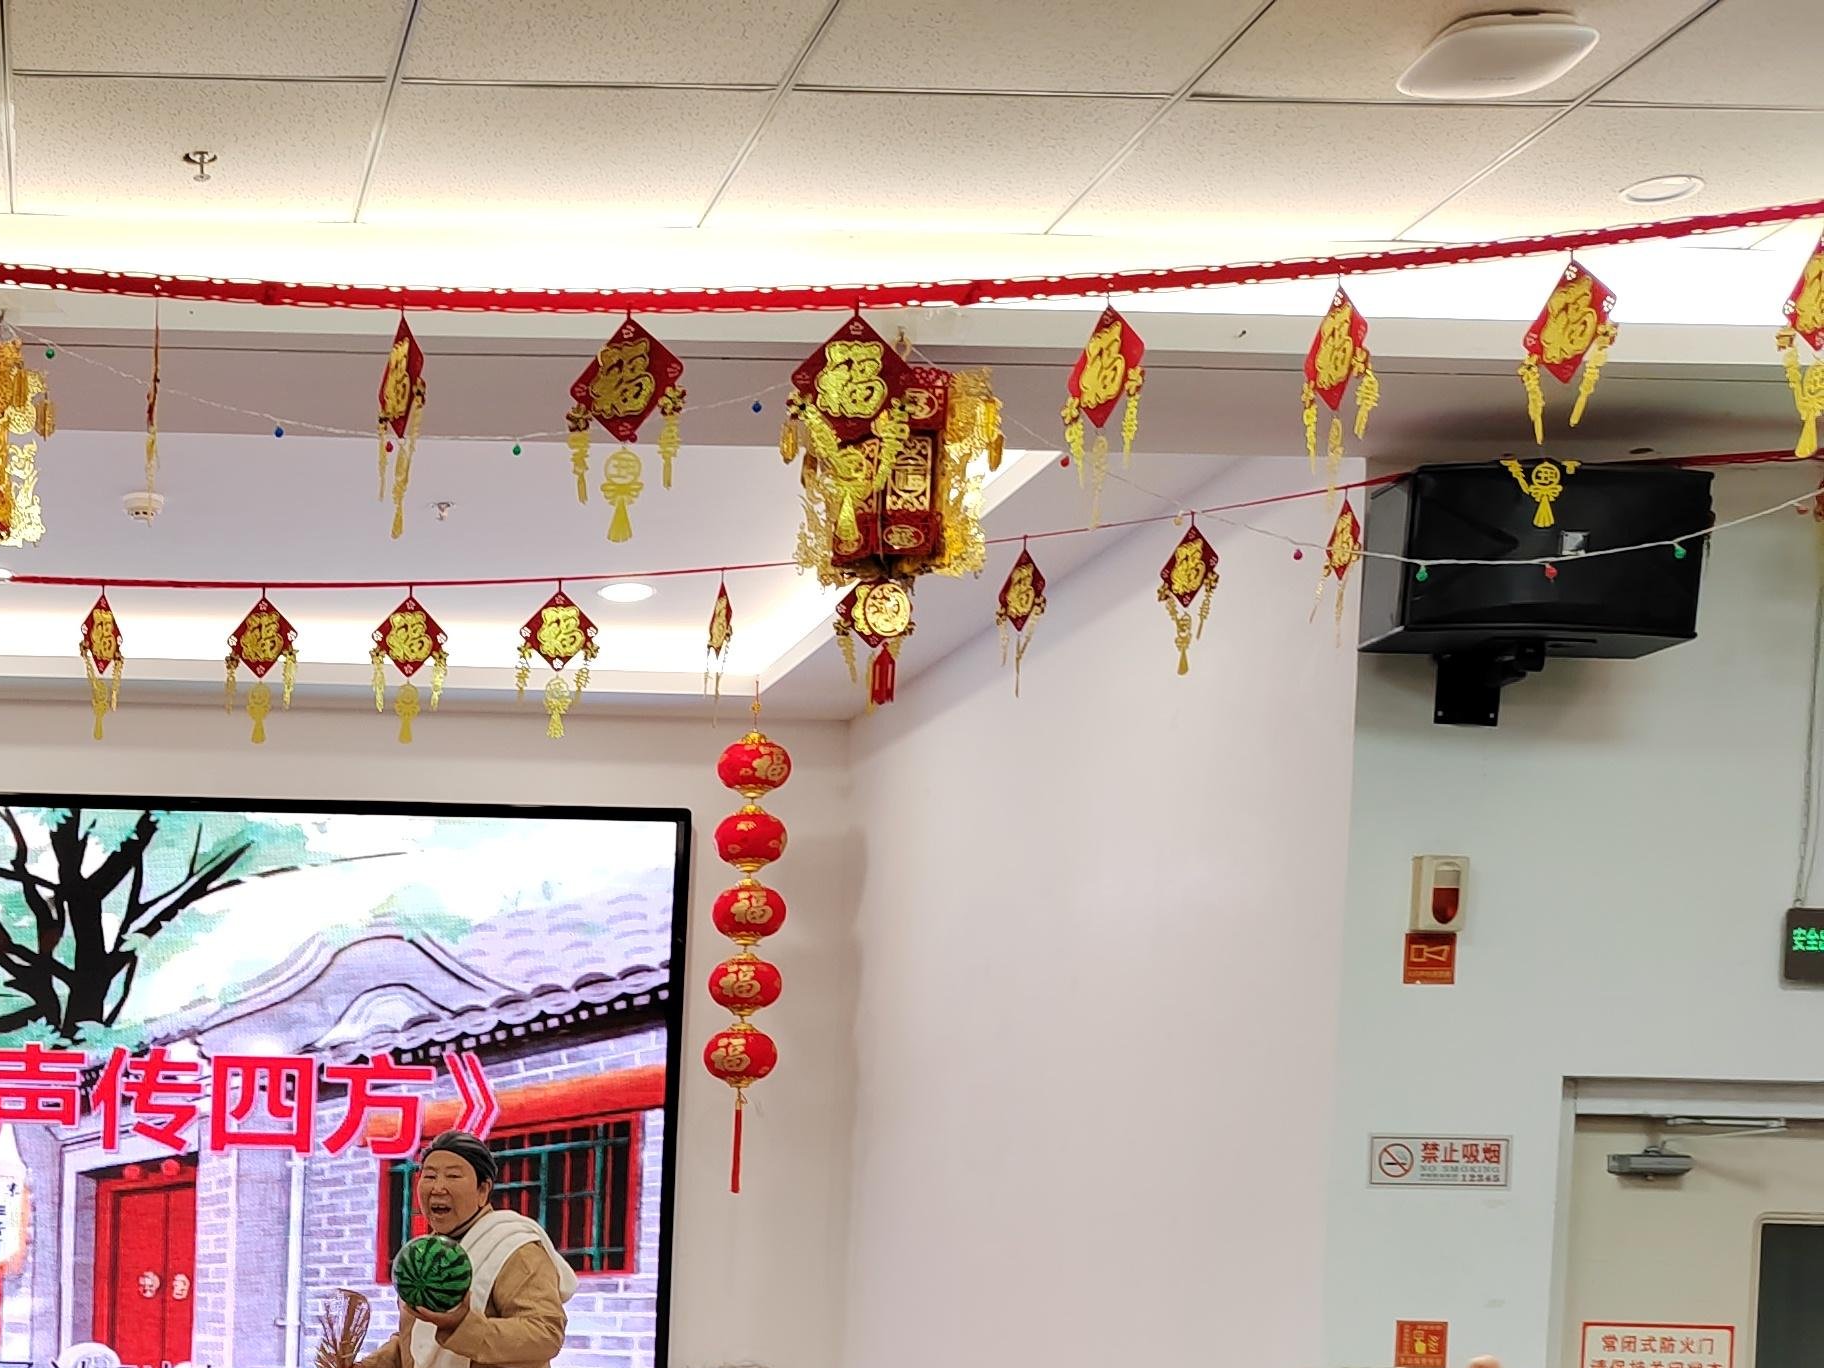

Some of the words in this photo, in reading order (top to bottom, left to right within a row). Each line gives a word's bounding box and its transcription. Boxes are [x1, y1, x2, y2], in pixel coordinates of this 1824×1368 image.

[1421, 1142, 1501, 1164] 禁止吸烟
[1601, 1334, 1715, 1355] 常闭式防火门
